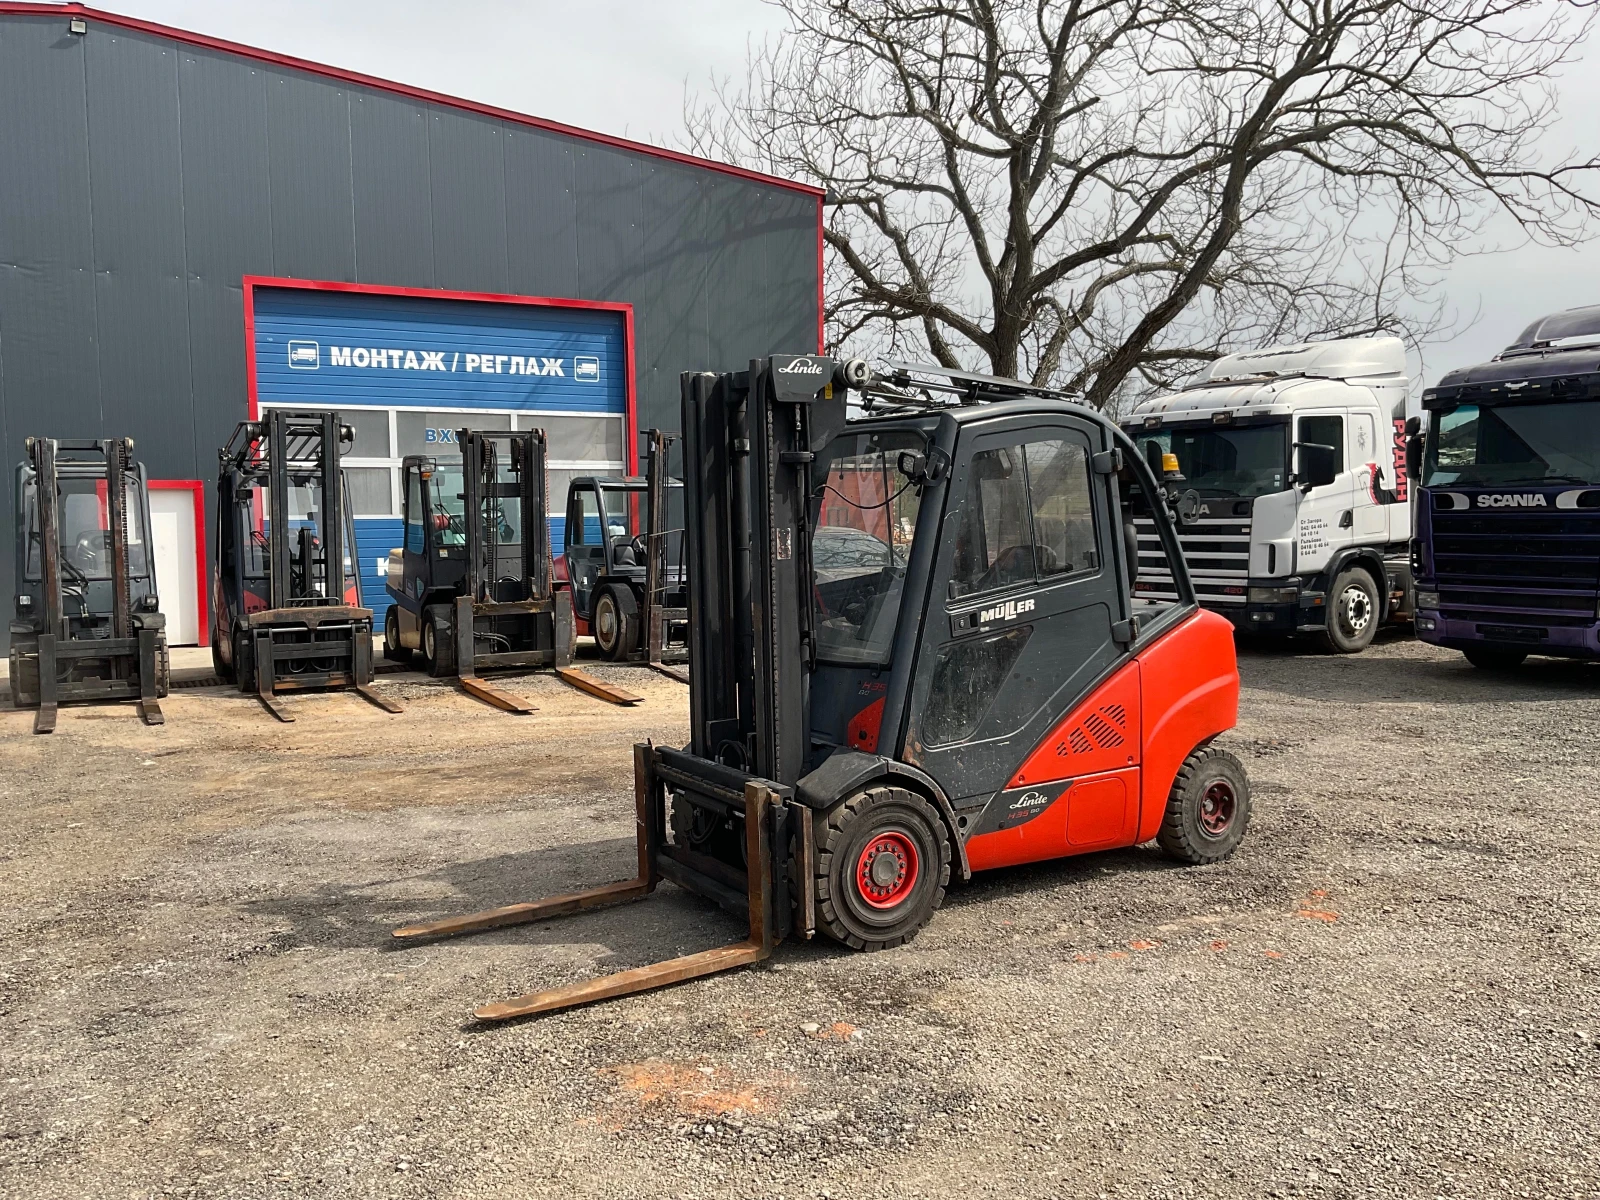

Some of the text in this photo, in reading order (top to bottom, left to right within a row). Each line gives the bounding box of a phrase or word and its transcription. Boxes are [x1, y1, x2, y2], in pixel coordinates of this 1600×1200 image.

[330, 346, 566, 377] МОНТАЖ / РЕГЛАЖ
[778, 357, 823, 374] Linde
[1477, 493, 1548, 508] SCANIA
[1009, 791, 1048, 809] Linde
